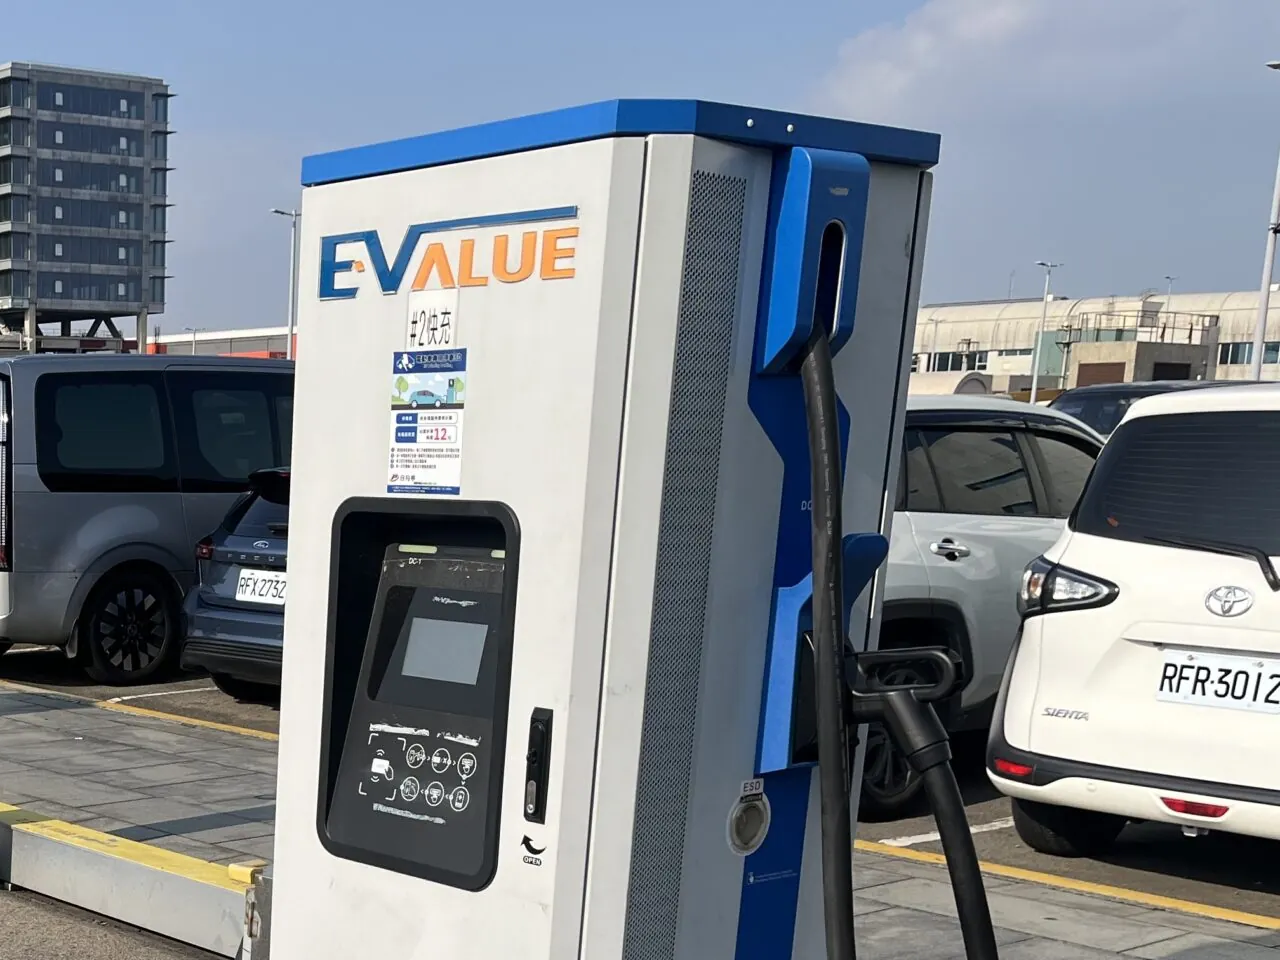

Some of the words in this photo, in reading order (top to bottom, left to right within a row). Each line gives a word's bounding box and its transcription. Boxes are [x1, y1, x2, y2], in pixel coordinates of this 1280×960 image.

[317, 205, 580, 301] EVALUE
[1042, 707, 1089, 721] SIENTA
[743, 780, 761, 793] ESD
[524, 856, 541, 866] OPEN
